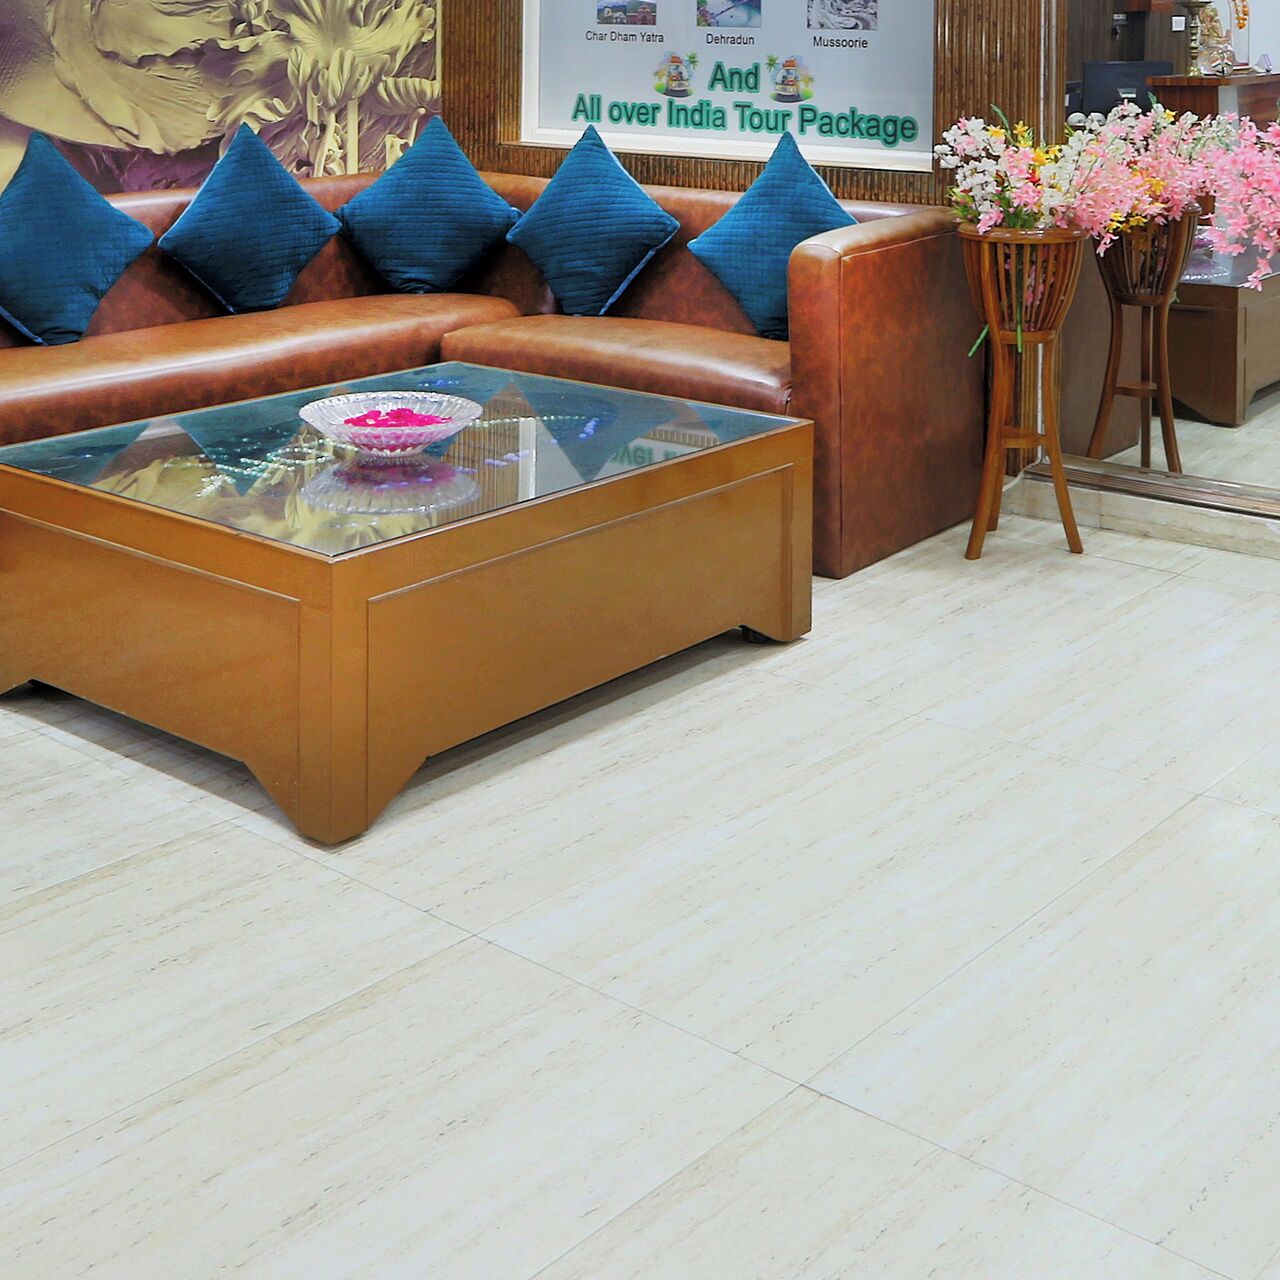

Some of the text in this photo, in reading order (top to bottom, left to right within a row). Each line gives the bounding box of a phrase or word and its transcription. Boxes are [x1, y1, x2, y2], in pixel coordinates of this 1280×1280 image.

[585, 31, 665, 45] Char Dham Yatra
[706, 33, 755, 47] Dehradun
[813, 36, 868, 50] Mussoorie
[708, 61, 760, 94] And
[572, 94, 918, 148] All over India Tour Package
